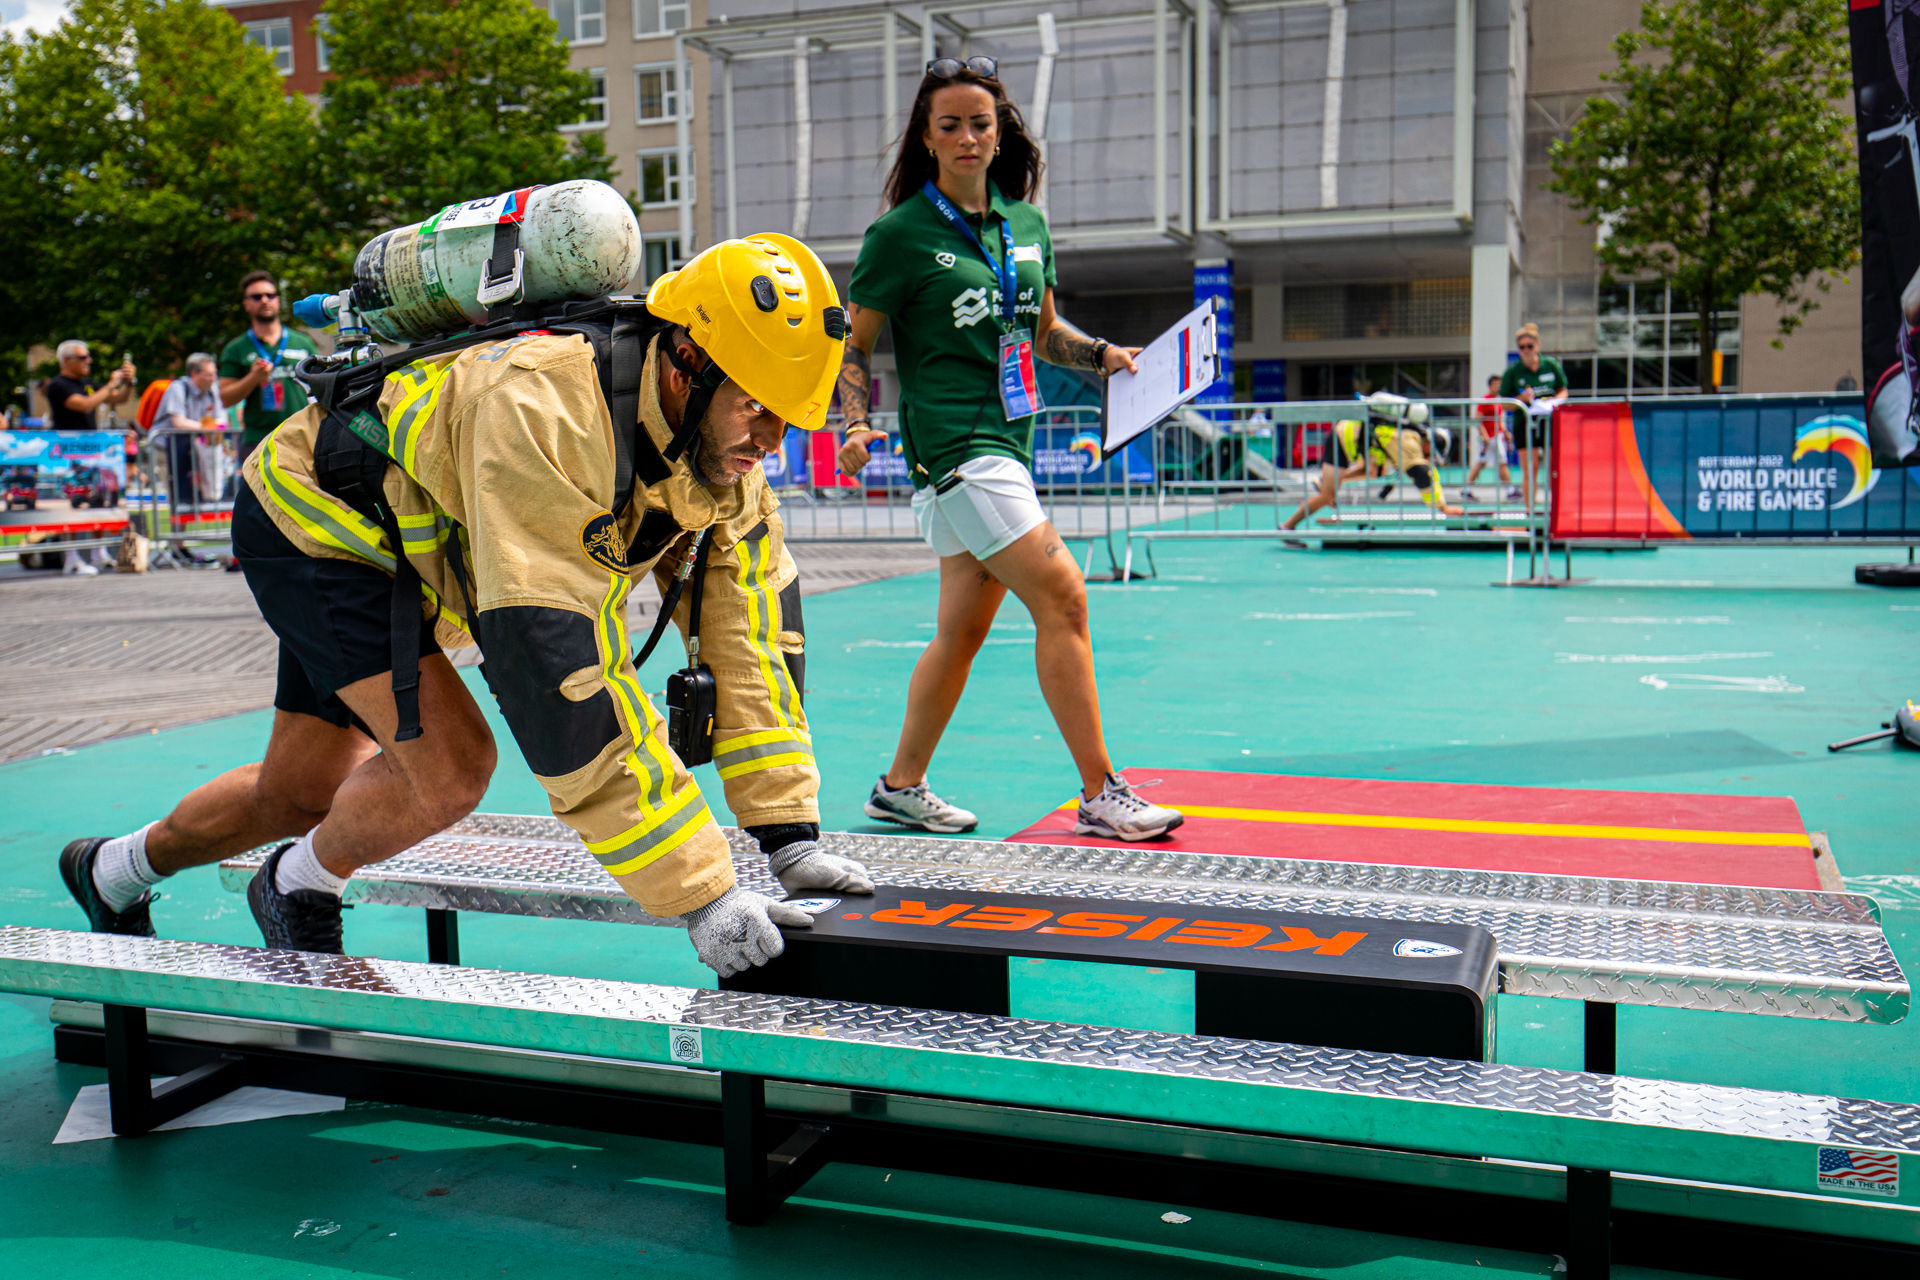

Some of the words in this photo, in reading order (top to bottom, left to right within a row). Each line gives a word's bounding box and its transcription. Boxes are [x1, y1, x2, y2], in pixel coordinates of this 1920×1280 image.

[1018, 287, 1034, 301] of
[1698, 469, 1769, 490] WORLD
[1772, 468, 1837, 489] POLICE
[1698, 490, 1712, 512] &
[1716, 490, 1756, 511] FIRE
[1759, 489, 1825, 511] GAMES
[870, 899, 1369, 956] KEISER
[1819, 1177, 1844, 1185] MADE
[1858, 1181, 1875, 1189] THE
[1877, 1183, 1897, 1191] USA
